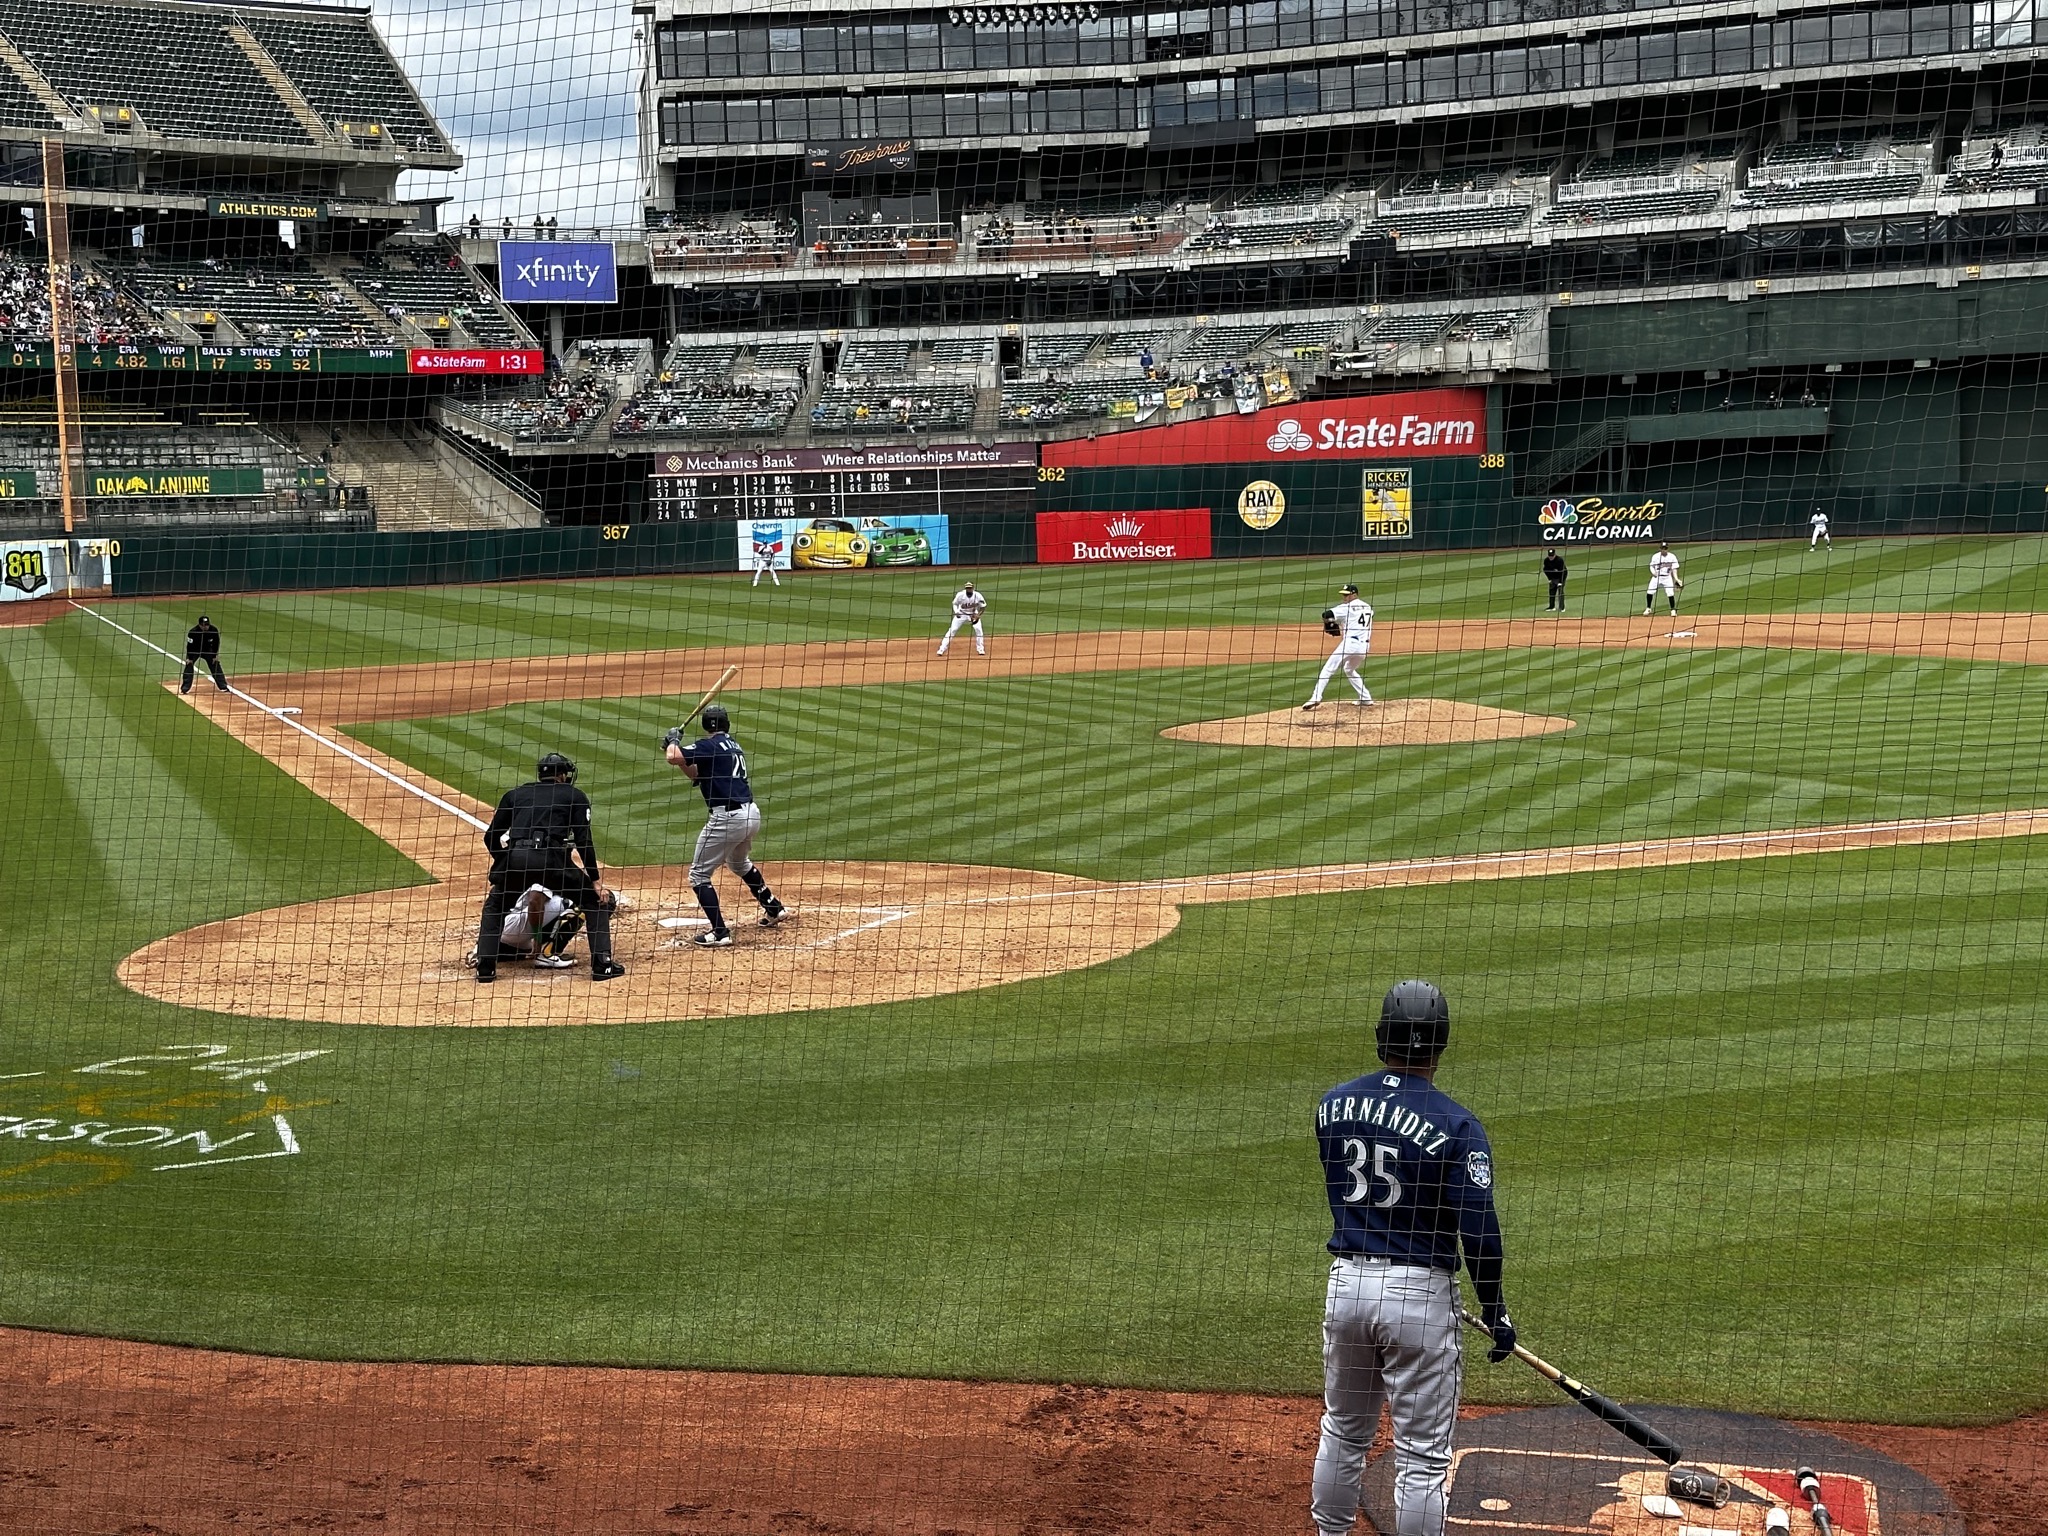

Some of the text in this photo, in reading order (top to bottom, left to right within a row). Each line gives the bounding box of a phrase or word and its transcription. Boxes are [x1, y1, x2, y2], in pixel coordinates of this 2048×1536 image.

[836, 140, 911, 171] Treehouse
[218, 203, 318, 218] ATHLETICS.COM
[517, 257, 600, 287] xfinity
[14, 344, 35, 352] W-L
[91, 345, 99, 353] K
[119, 346, 139, 355] ERA
[158, 346, 186, 355] WHIP
[201, 347, 233, 356] BALLS
[240, 348, 281, 358] STRIKES
[291, 349, 310, 357] TOT
[369, 350, 393, 359] MPH
[62, 354, 72, 367] 2
[93, 355, 102, 367] 4
[115, 355, 148, 368] 4.82
[163, 356, 186, 368] 1.61
[212, 358, 226, 370] 17
[253, 358, 272, 370] 35
[292, 359, 311, 371] 52
[686, 450, 1001, 470] Mechanics Bank Where Relationships Matter
[1479, 454, 1505, 469] 388
[733, 476, 739, 486] 0
[774, 475, 793, 485] BAL
[829, 474, 836, 483] 8
[870, 472, 890, 482] TOR
[1037, 467, 1066, 482] 362
[1367, 472, 1407, 482] RICKEY
[96, 476, 210, 495] OAK LANDING
[677, 488, 697, 497] DET
[734, 486, 739, 496] 2
[712, 482, 717, 492] F
[870, 483, 890, 492] BOS
[680, 500, 697, 510] PIT
[734, 499, 740, 508] 2
[774, 497, 794, 507] MIN
[830, 496, 836, 506] 2
[1246, 489, 1277, 507] RAY
[713, 504, 718, 514] F
[774, 507, 796, 517] CWS
[831, 506, 836, 515] 2
[810, 501, 815, 511] 9
[1576, 497, 1664, 529] Sports
[602, 525, 630, 540] 367
[752, 522, 783, 530] Chevron
[1367, 522, 1408, 536] FIELD
[1543, 524, 1653, 540] CALIFORNIA
[1072, 541, 1176, 560] Budweiser
[8, 552, 42, 577] 811
[1358, 612, 1371, 628] 47
[731, 753, 748, 779] 29
[1318, 1093, 1449, 1156] HERNÁNDEZ
[1342, 1136, 1402, 1208] 35
